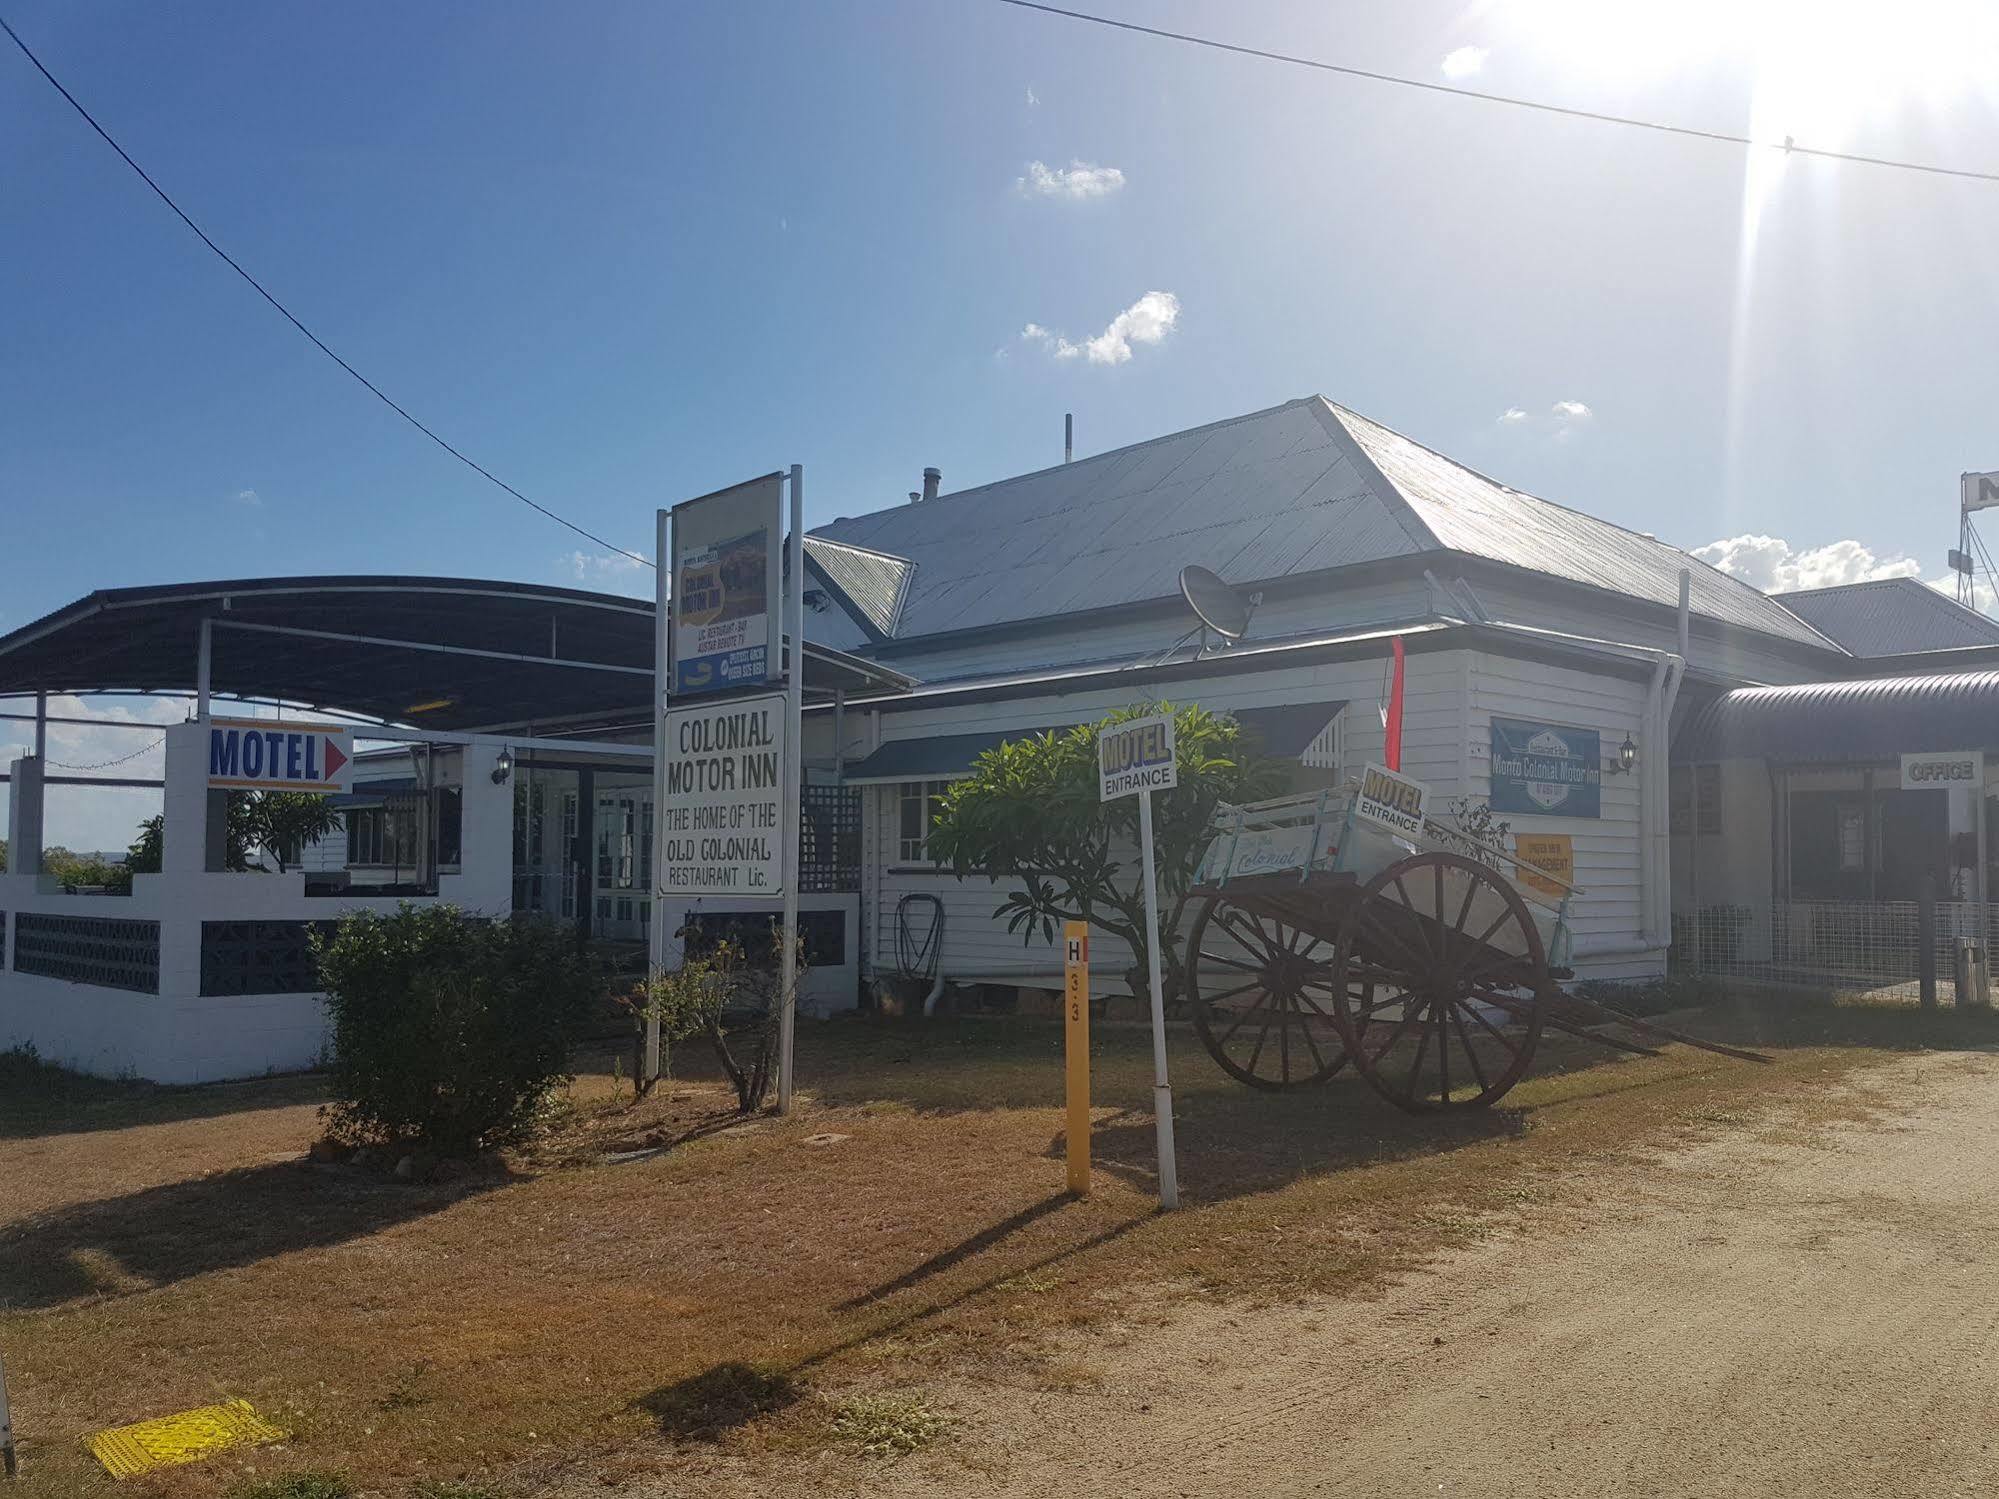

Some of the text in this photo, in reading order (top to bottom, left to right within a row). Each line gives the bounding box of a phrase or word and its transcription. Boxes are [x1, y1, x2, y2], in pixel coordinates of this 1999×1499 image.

[680, 711, 774, 754] COLONIAL
[210, 729, 319, 780] MOTEL
[1103, 723, 1172, 776] MOTEL
[668, 752, 778, 794] MOTOR INN
[1106, 768, 1171, 795] ENTRANCE
[1492, 752, 1522, 776] Monto
[1524, 757, 1558, 780] Colonial
[1560, 761, 1584, 782] Motor
[1909, 761, 1975, 780] OFFICE
[1363, 767, 1422, 820] MOTEL
[667, 803, 776, 831] THE HOME OF THE
[1362, 802, 1418, 832] ENTRANCE
[667, 837, 771, 861] OLD COLONIAL
[1237, 847, 1297, 873] Colonial
[670, 867, 767, 887] RESTAURANT Lic.
[1069, 941, 1080, 961] H
